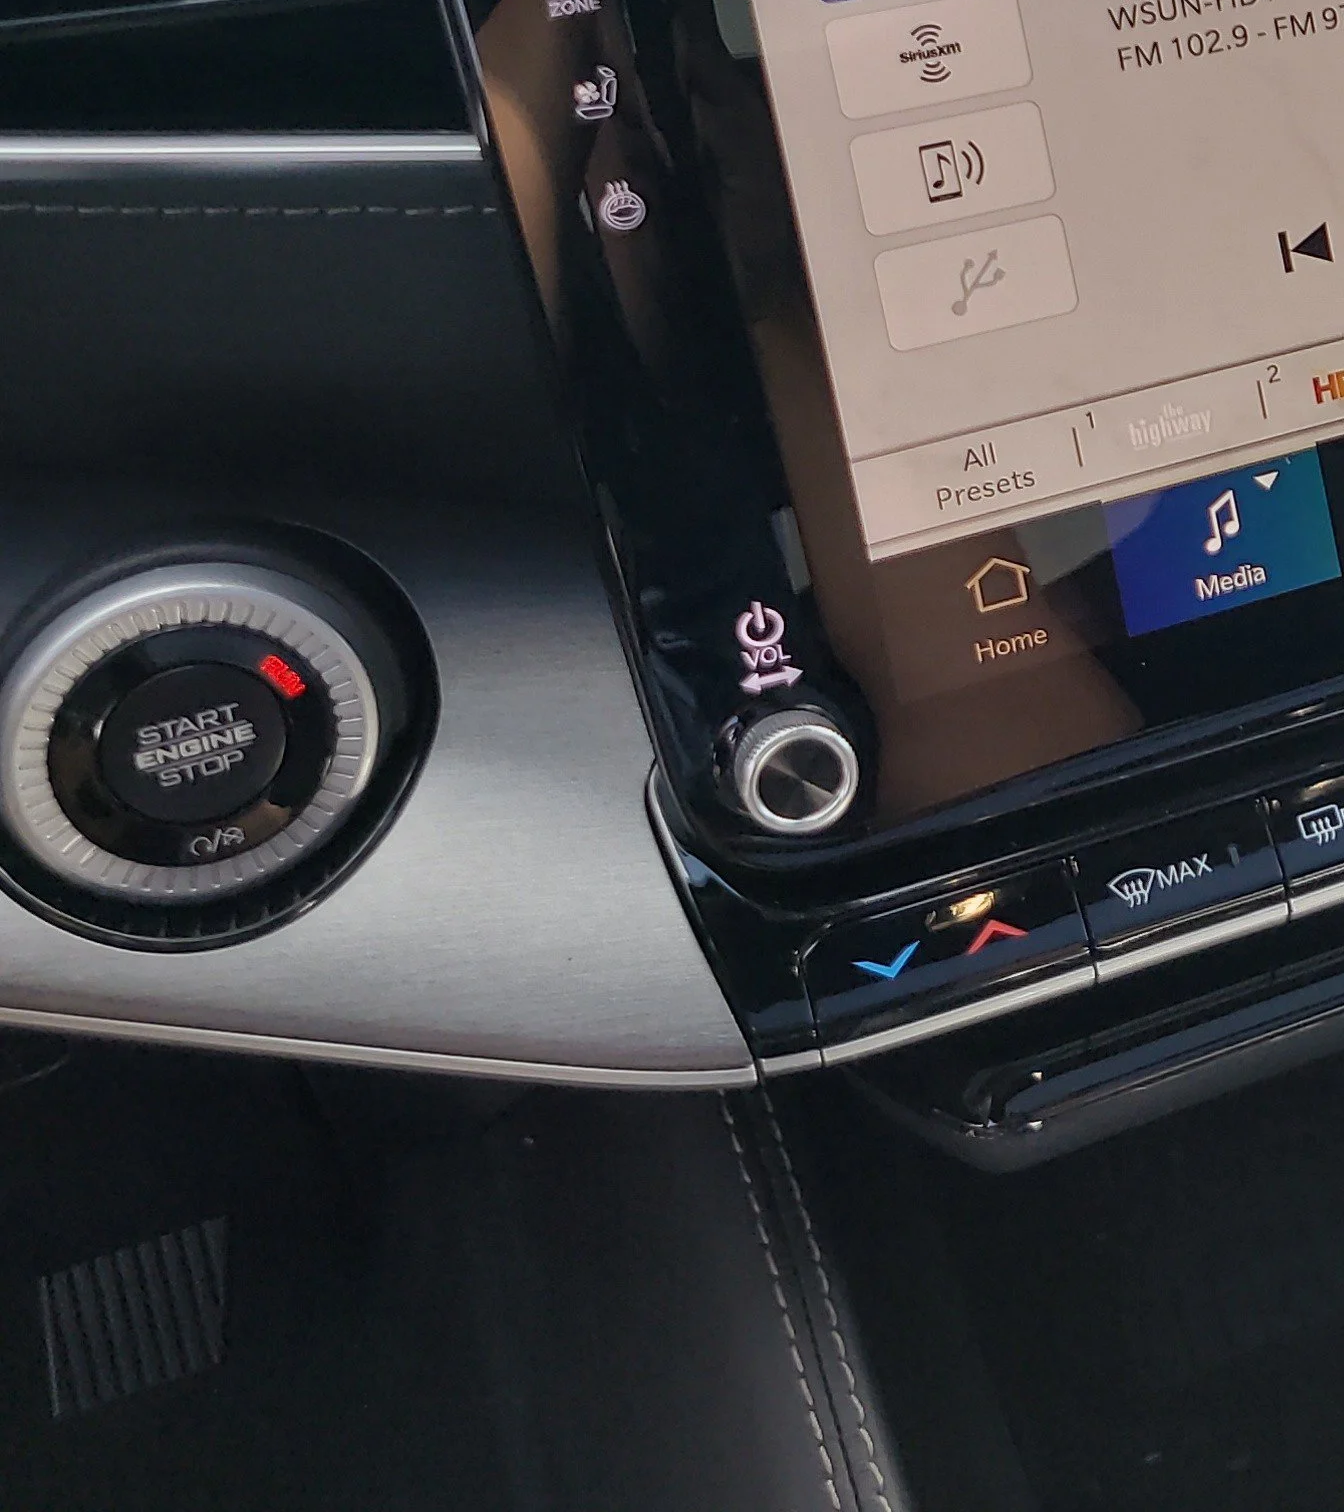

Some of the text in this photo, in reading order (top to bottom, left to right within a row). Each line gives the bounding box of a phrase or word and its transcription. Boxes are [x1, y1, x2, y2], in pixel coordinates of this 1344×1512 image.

[1117, 40, 1164, 72] FM
[1171, 23, 1250, 63] 102.9
[1274, 11, 1317, 41] FM
[1267, 364, 1282, 384] 2
[1085, 411, 1095, 429] 1
[1128, 407, 1213, 448] highway
[962, 442, 997, 471] All
[935, 466, 1037, 511] Presets
[1194, 562, 1268, 601] Media
[740, 642, 792, 671] VOL
[973, 627, 1049, 664] Home
[137, 702, 240, 746] START
[133, 722, 257, 771] ENGINE
[155, 748, 245, 787] STOP
[1155, 853, 1214, 890] MAX
